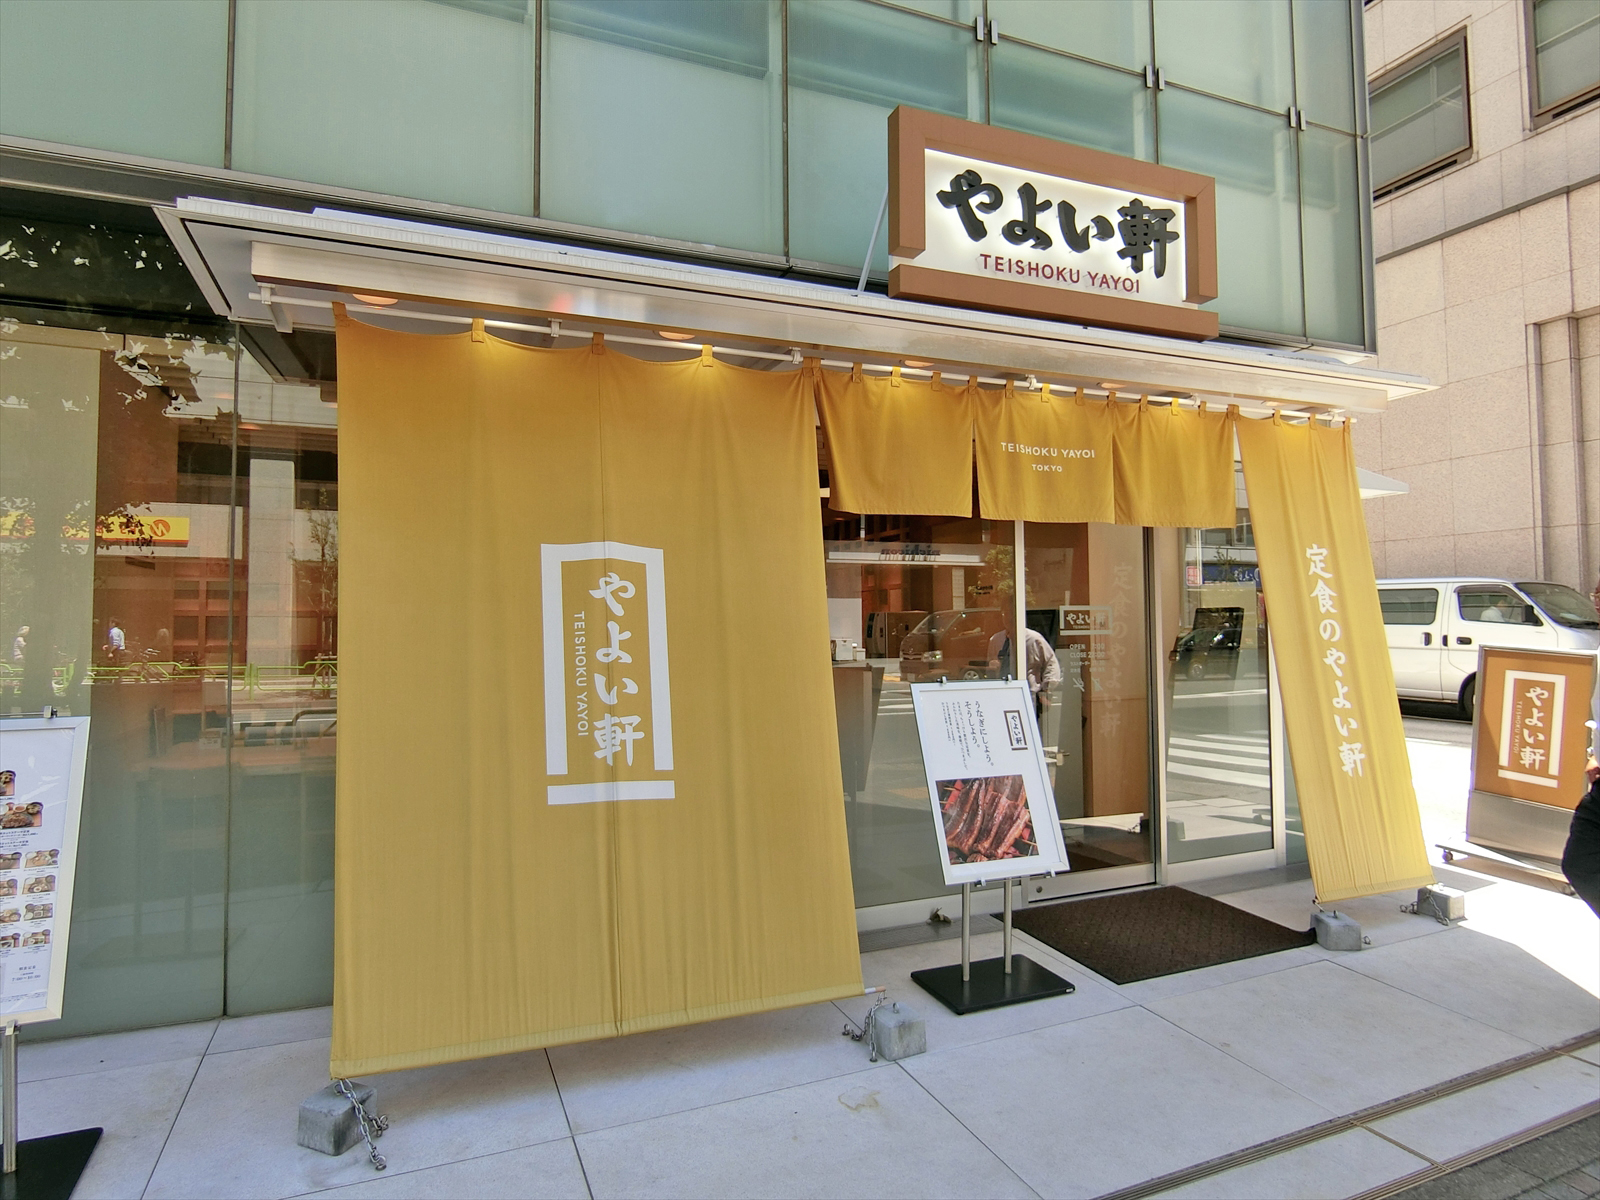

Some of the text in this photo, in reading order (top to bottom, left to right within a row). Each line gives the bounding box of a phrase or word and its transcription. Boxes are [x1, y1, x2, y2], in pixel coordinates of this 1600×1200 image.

[936, 169, 1180, 279] やよい軒
[979, 253, 1141, 293] TEISHOKU YAYOI
[1000, 441, 1096, 458] TEISHOKU YAYOI
[1031, 464, 1063, 473] TOKYO
[574, 611, 589, 737] TEISHOKU YAYOI
[588, 572, 645, 767] やよい軒
[1305, 543, 1366, 778] 定食のやよい軒
[964, 701, 981, 748] そうしよう。
[975, 701, 994, 767] うなぎにしよう。
[1519, 686, 1550, 770] やよい軒
